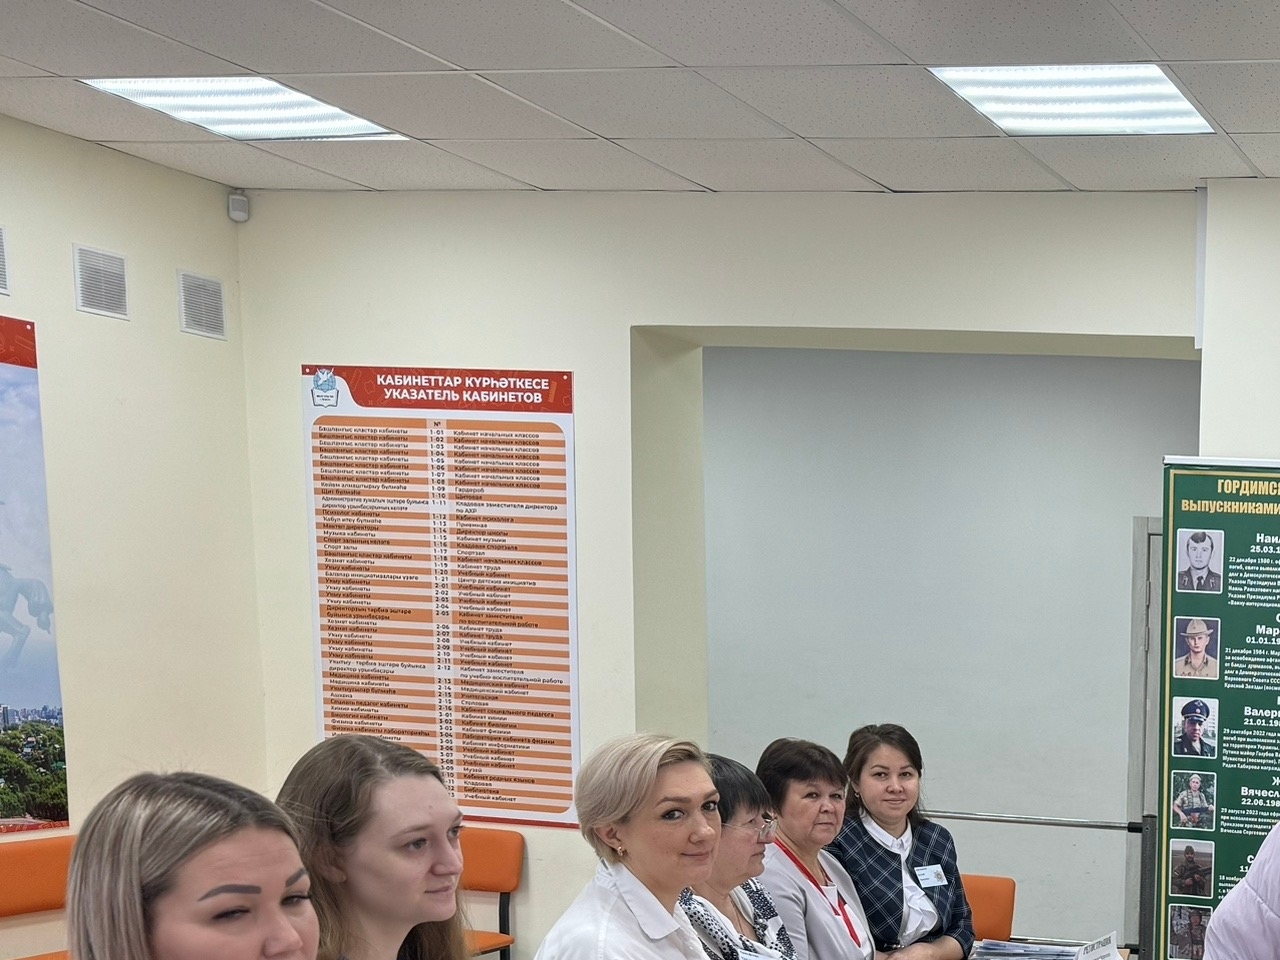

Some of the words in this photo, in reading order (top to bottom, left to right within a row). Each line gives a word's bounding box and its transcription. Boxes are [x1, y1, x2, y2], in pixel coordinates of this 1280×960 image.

[376, 374, 462, 387] КАБИНЕТТАР
[465, 376, 549, 389] КҮРҺӘТКЕСЕ
[383, 387, 459, 401] УКАЗАТЕЛЬ
[462, 390, 542, 403] КАБИНЕТОВ
